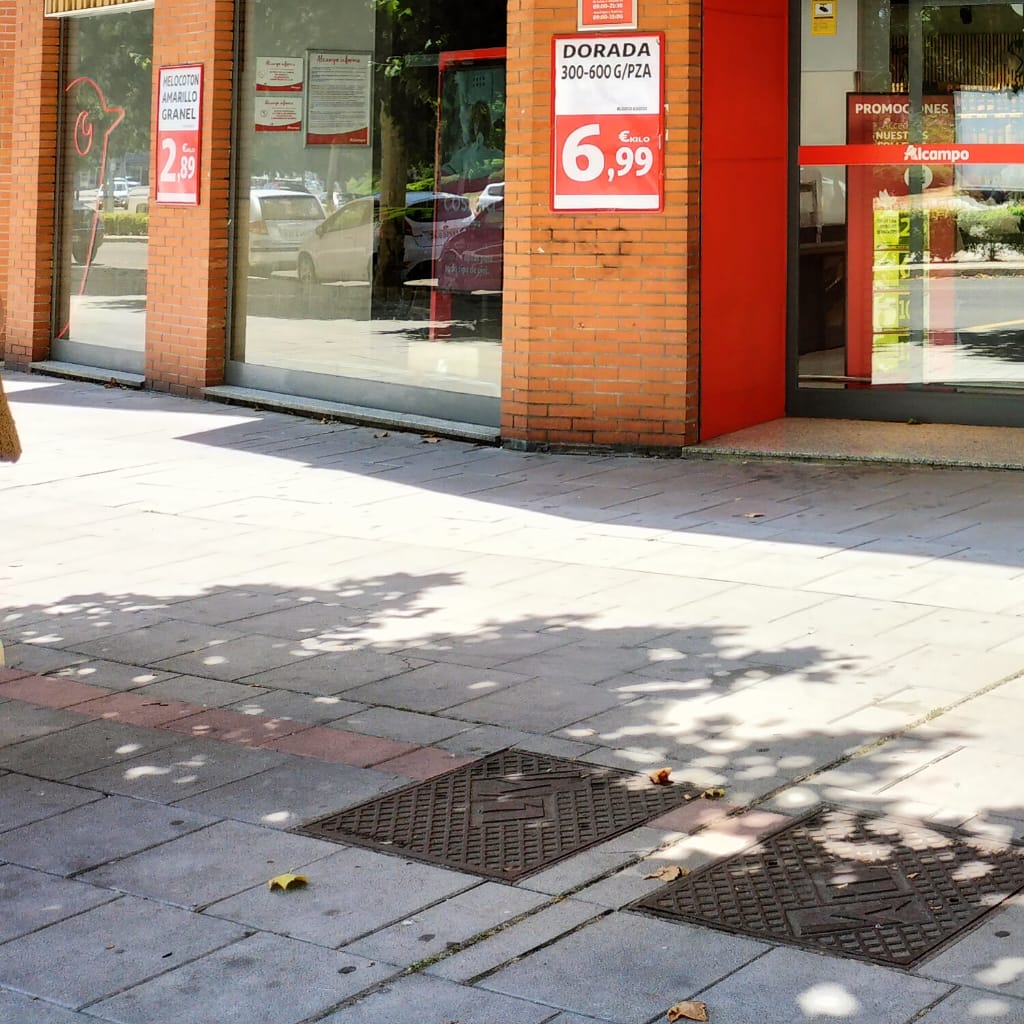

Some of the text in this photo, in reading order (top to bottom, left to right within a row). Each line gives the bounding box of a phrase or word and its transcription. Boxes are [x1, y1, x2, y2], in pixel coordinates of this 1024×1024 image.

[563, 43, 651, 59] DORADA
[561, 63, 652, 80] 300-600 G/PZA
[163, 74, 199, 87] MELOCOTON
[162, 91, 198, 103] AMARILLO
[162, 108, 196, 120] GRANEL
[855, 103, 948, 114] PROMOCNES
[876, 131, 928, 140] NUESTS
[904, 144, 970, 163] Alcampo
